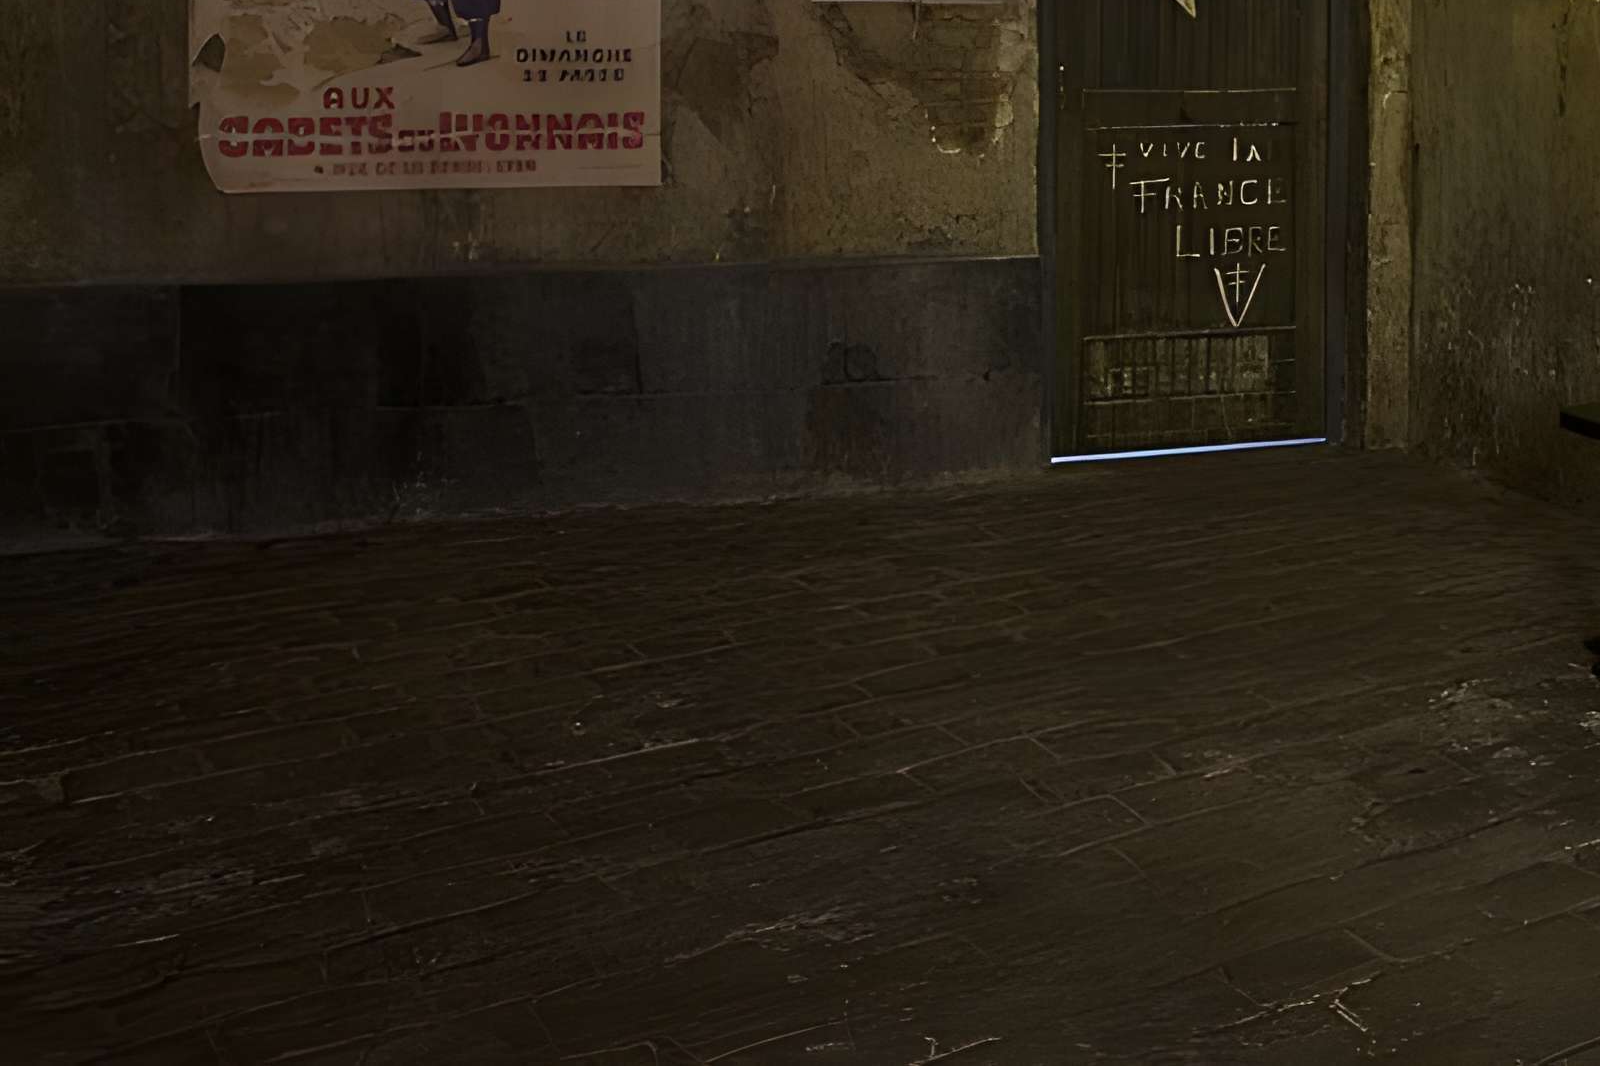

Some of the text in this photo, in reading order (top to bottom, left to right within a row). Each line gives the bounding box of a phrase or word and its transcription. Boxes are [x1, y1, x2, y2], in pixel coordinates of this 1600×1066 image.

[322, 86, 396, 110] AUX
[1128, 177, 1288, 215] FRANCE
[1175, 224, 1288, 258] LIBRE
